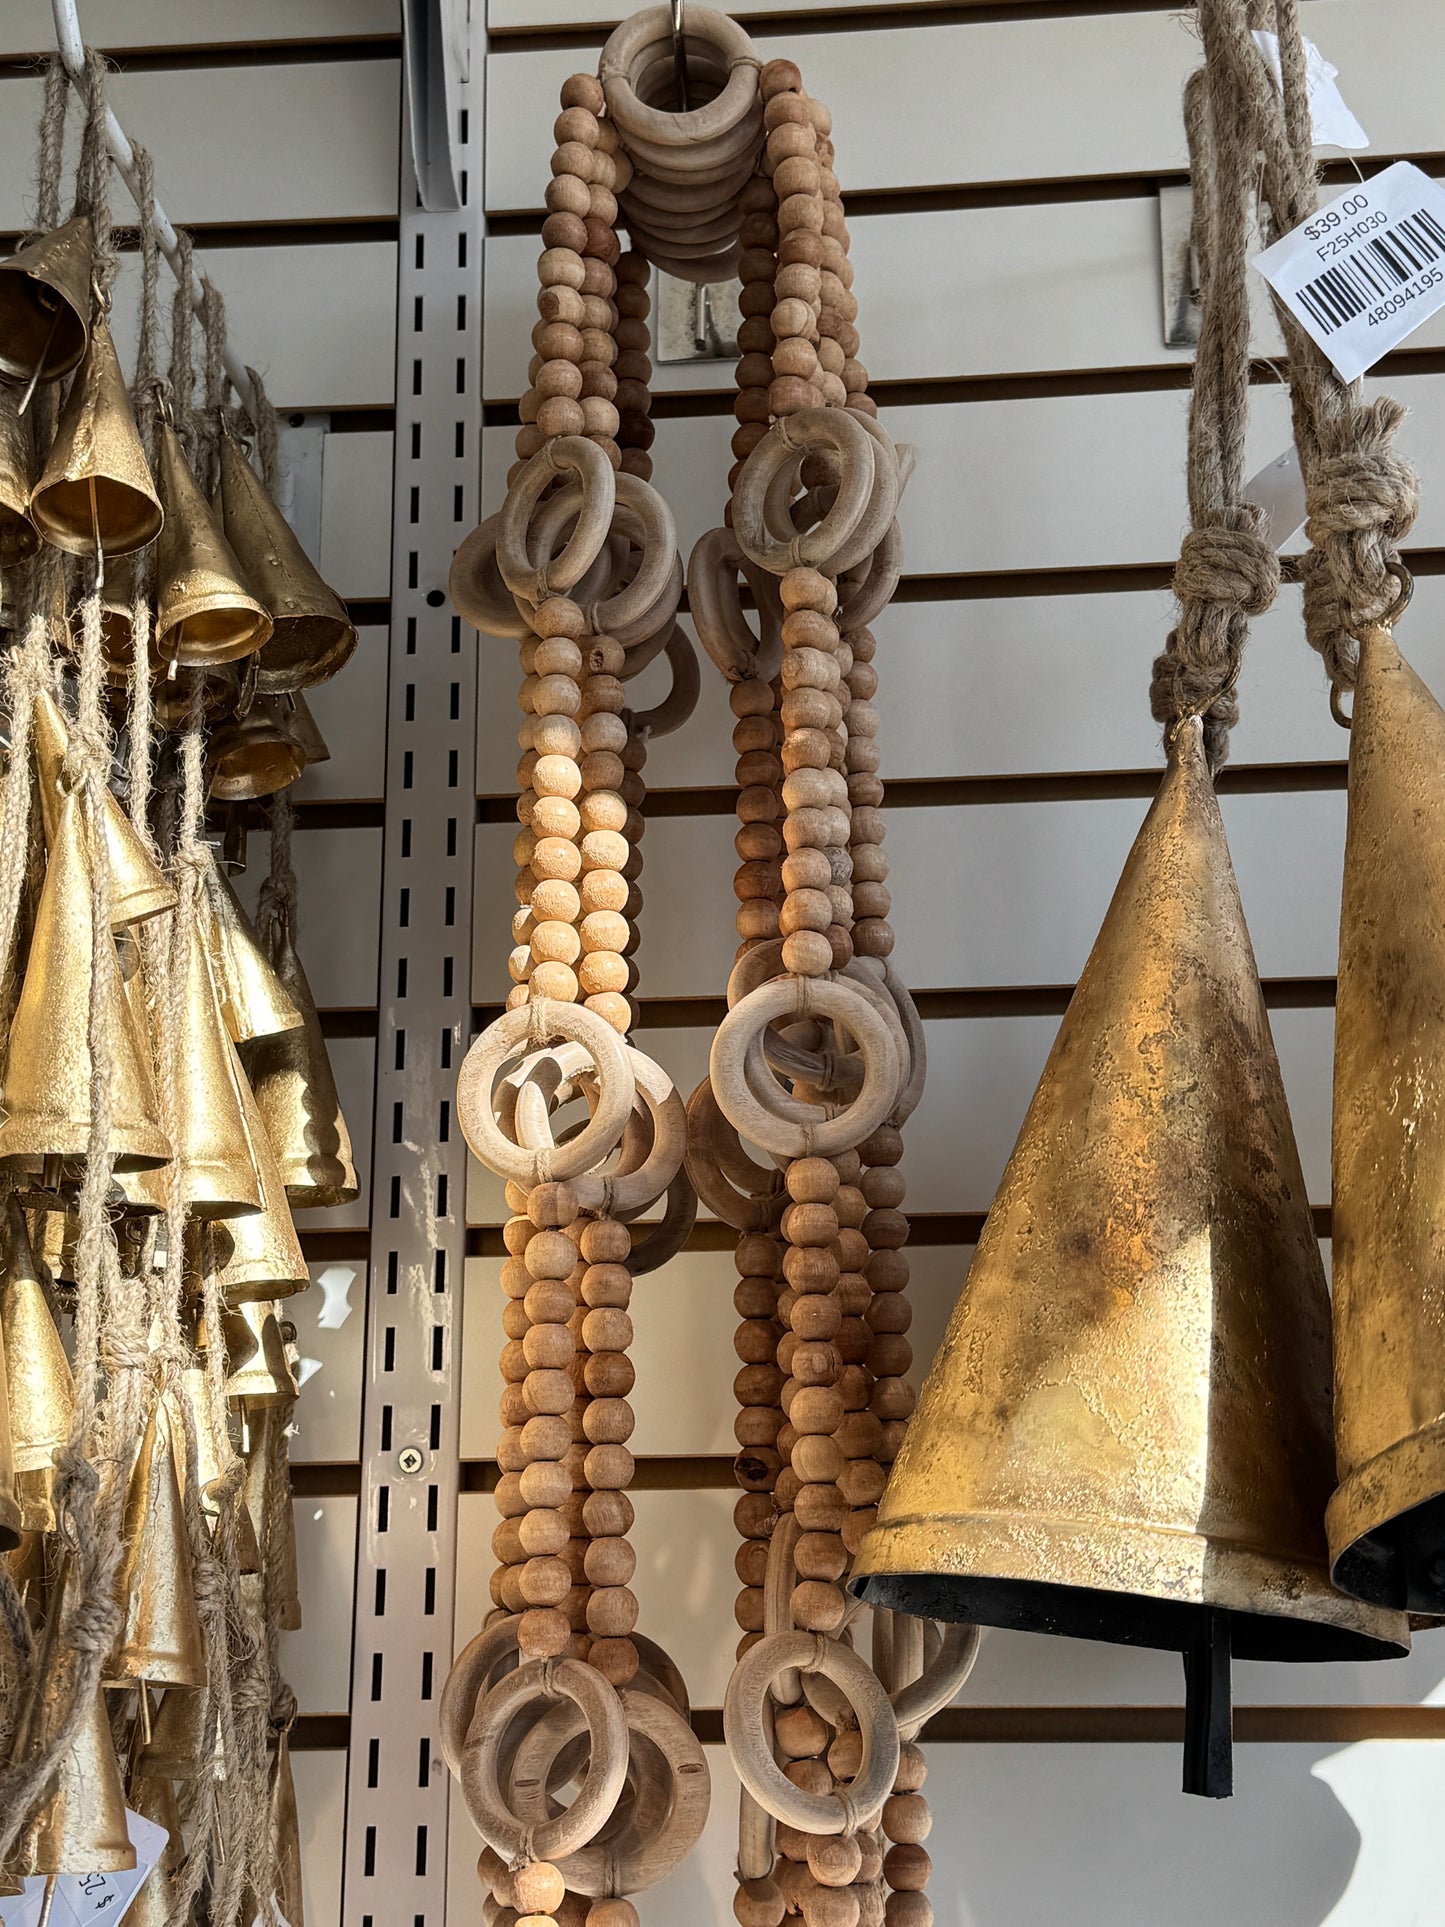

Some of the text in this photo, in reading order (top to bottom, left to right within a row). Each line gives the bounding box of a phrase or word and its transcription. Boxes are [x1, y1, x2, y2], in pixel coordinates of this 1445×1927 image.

[1304, 194, 1369, 241] $39.00
[1316, 211, 1388, 262] F25H030
[1367, 267, 1444, 327] 48094195
